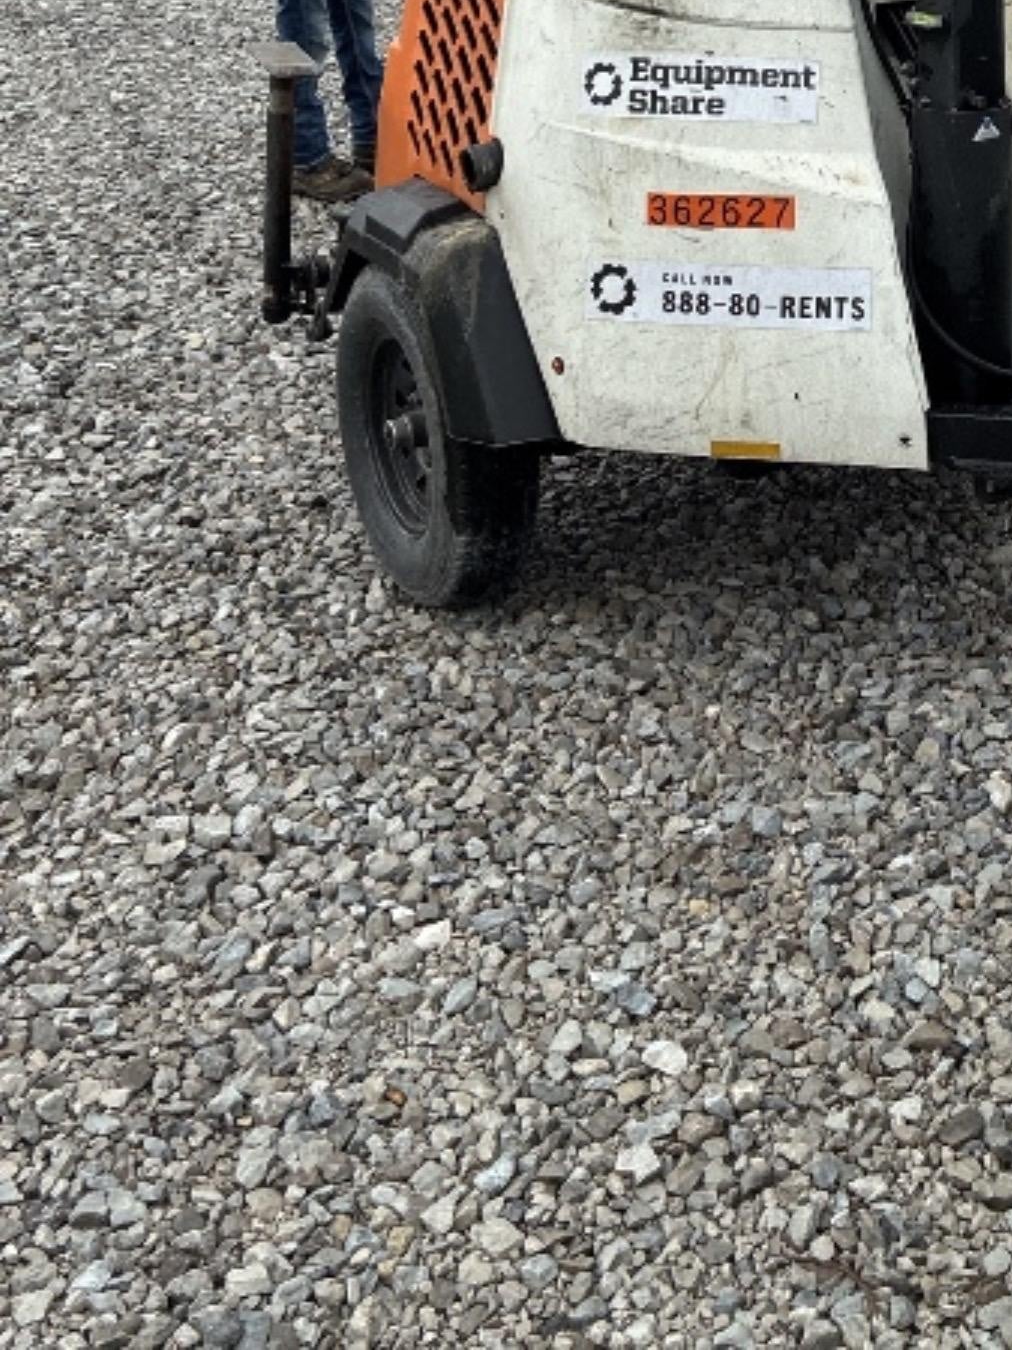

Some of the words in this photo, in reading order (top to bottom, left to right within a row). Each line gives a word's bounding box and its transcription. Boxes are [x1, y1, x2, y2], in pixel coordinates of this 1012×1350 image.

[629, 57, 816, 90] Equipment
[627, 89, 725, 115] Share
[649, 194, 791, 229] 362627
[662, 272, 697, 286] CALL
[661, 290, 866, 321] 888-80-RENTS
